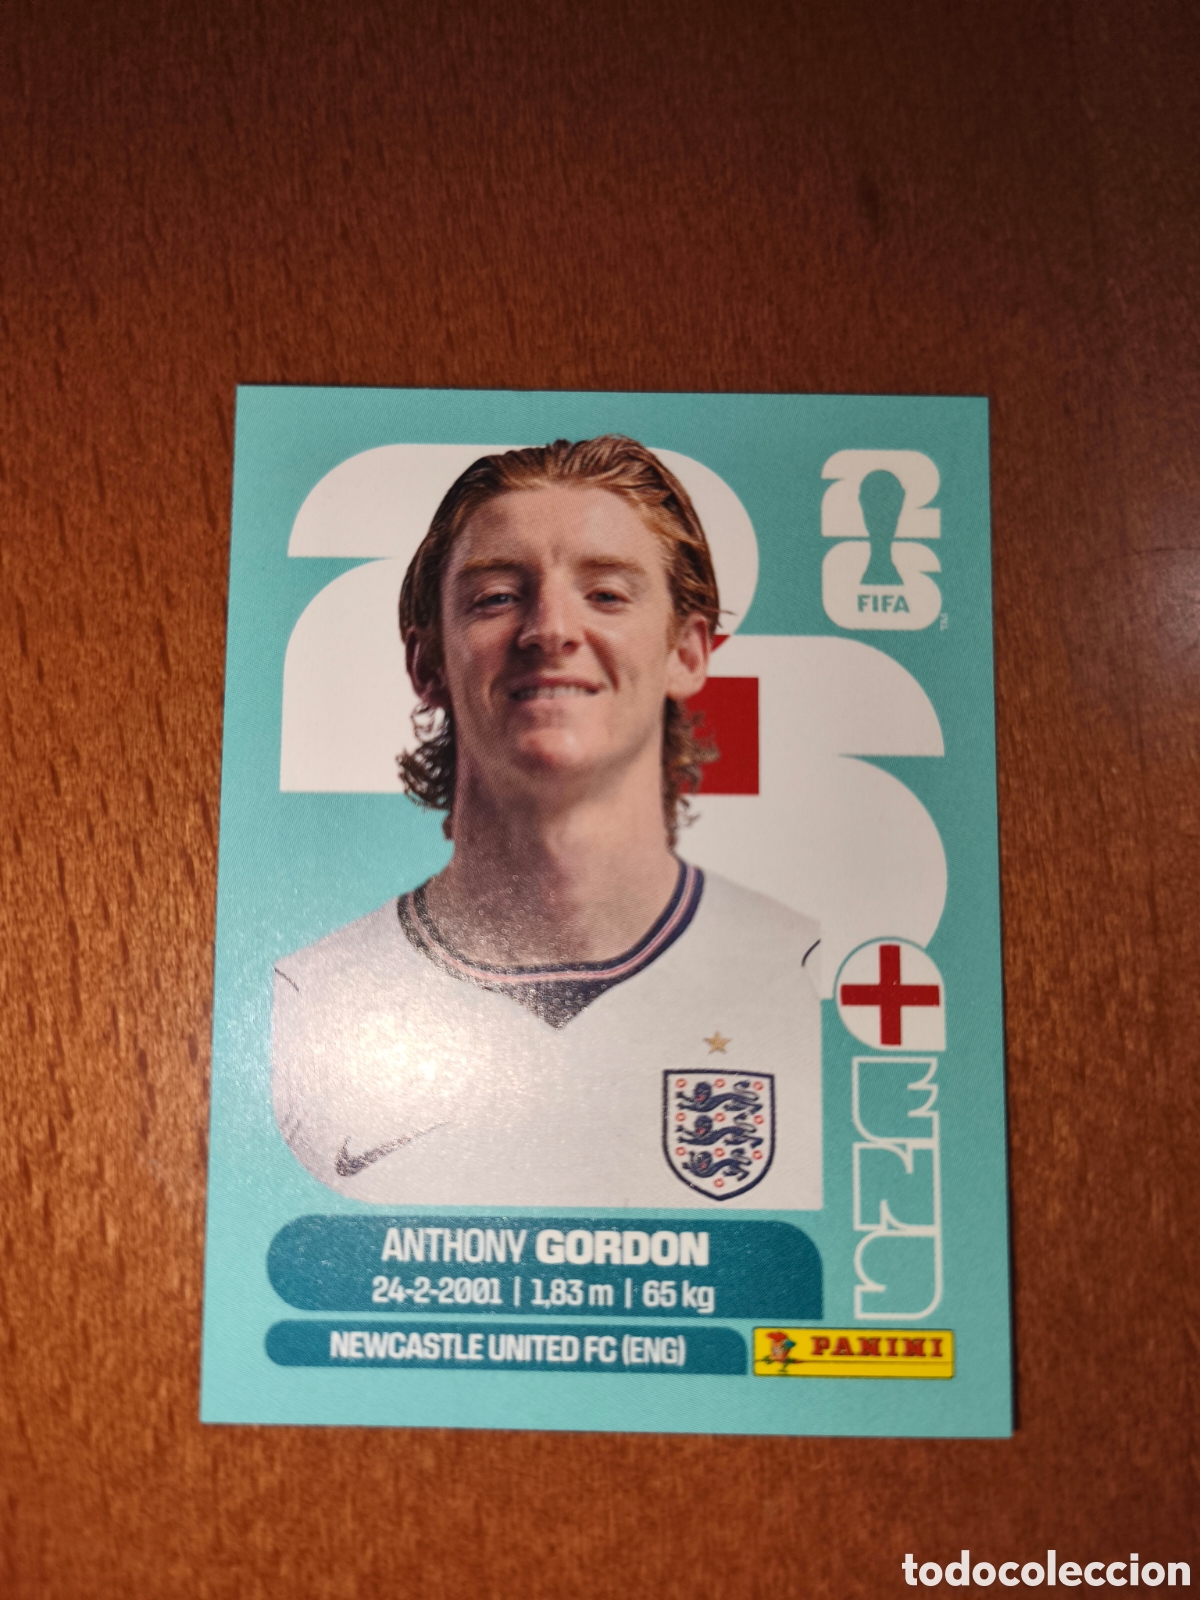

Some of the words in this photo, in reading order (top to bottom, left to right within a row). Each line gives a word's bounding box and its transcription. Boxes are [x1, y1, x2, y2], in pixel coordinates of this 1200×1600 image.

[857, 594, 910, 613] FIFA
[381, 1227, 527, 1263] ANTHONY
[535, 1229, 709, 1266] GORDON
[372, 1275, 502, 1305] 24-2-2001
[530, 1278, 584, 1309] 1,83
[588, 1283, 614, 1306] m
[641, 1280, 677, 1308] 65
[681, 1280, 715, 1314] kg
[330, 1330, 484, 1361] NEWCASTLE
[488, 1334, 579, 1362] UNITED
[584, 1336, 617, 1363] FC
[622, 1334, 686, 1366] (ENG)
[810, 1336, 944, 1358] PANINI
